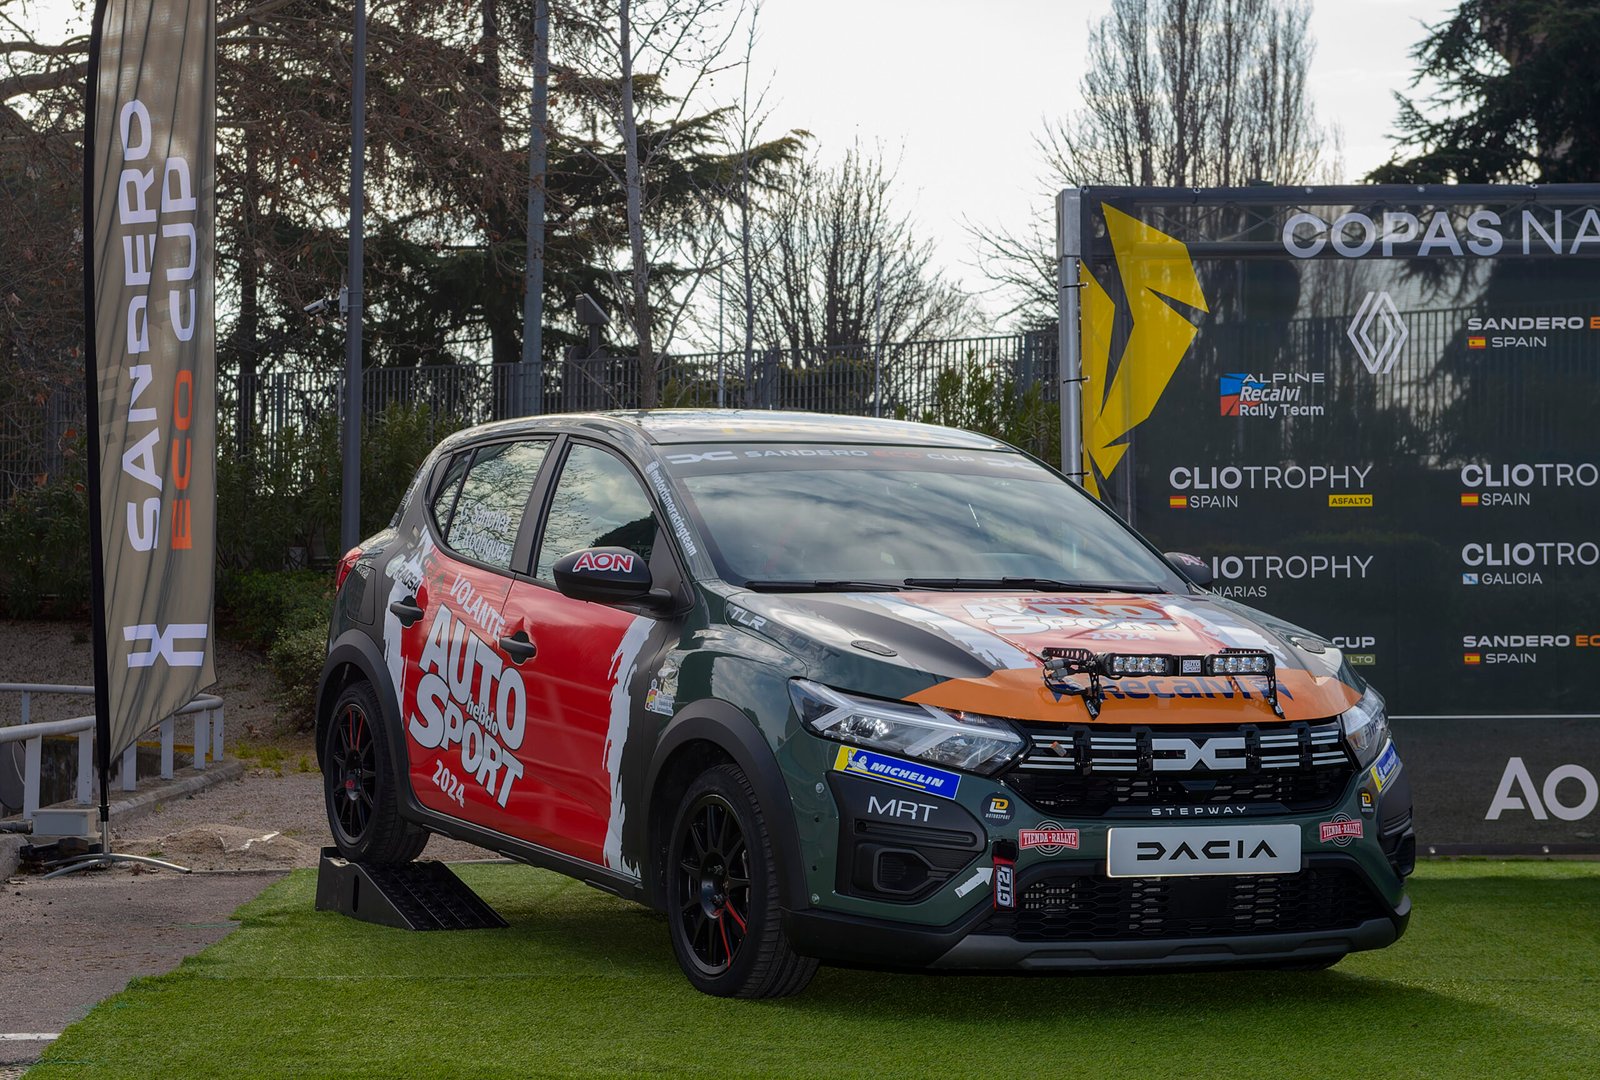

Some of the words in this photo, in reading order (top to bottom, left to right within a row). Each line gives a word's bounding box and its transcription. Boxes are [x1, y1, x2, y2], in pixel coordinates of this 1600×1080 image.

[1282, 209, 1503, 258] COPAS
[162, 157, 197, 342] CUP
[118, 99, 162, 552] SANDERO
[1467, 317, 1584, 331] SANDERO
[1491, 336, 1547, 348] SPAIN
[1243, 373, 1325, 383] ALPINE
[1240, 386, 1301, 402] Recalvi
[1240, 403, 1277, 419] Rally
[1280, 404, 1325, 416] Team
[171, 369, 193, 550] ECO
[744, 448, 868, 458] SANDERO
[1169, 465, 1374, 490] CLIOTROPHY
[1461, 463, 1599, 487] CLIOTRO
[1190, 495, 1238, 508] SPAIN
[1331, 497, 1371, 505] ASFALTO
[1481, 492, 1530, 506] SPAIN
[573, 552, 634, 573] AON
[1462, 542, 1600, 566] CLIOTRO
[1481, 572, 1543, 585] GALICIA
[448, 574, 506, 643] VOLANTE
[731, 606, 767, 631] TLR
[1332, 636, 1376, 649] CUP
[1463, 635, 1571, 648] SANDERO
[1485, 653, 1537, 664] SPAIN
[418, 602, 527, 751] AUTO
[465, 694, 500, 736] hebdo
[408, 672, 524, 808] SPORT
[432, 759, 466, 808] 2024
[870, 762, 944, 788] MICHELIN
[867, 796, 938, 822] MRT
[1151, 806, 1247, 816] STEPWAY
[1136, 839, 1278, 861] DACIA
